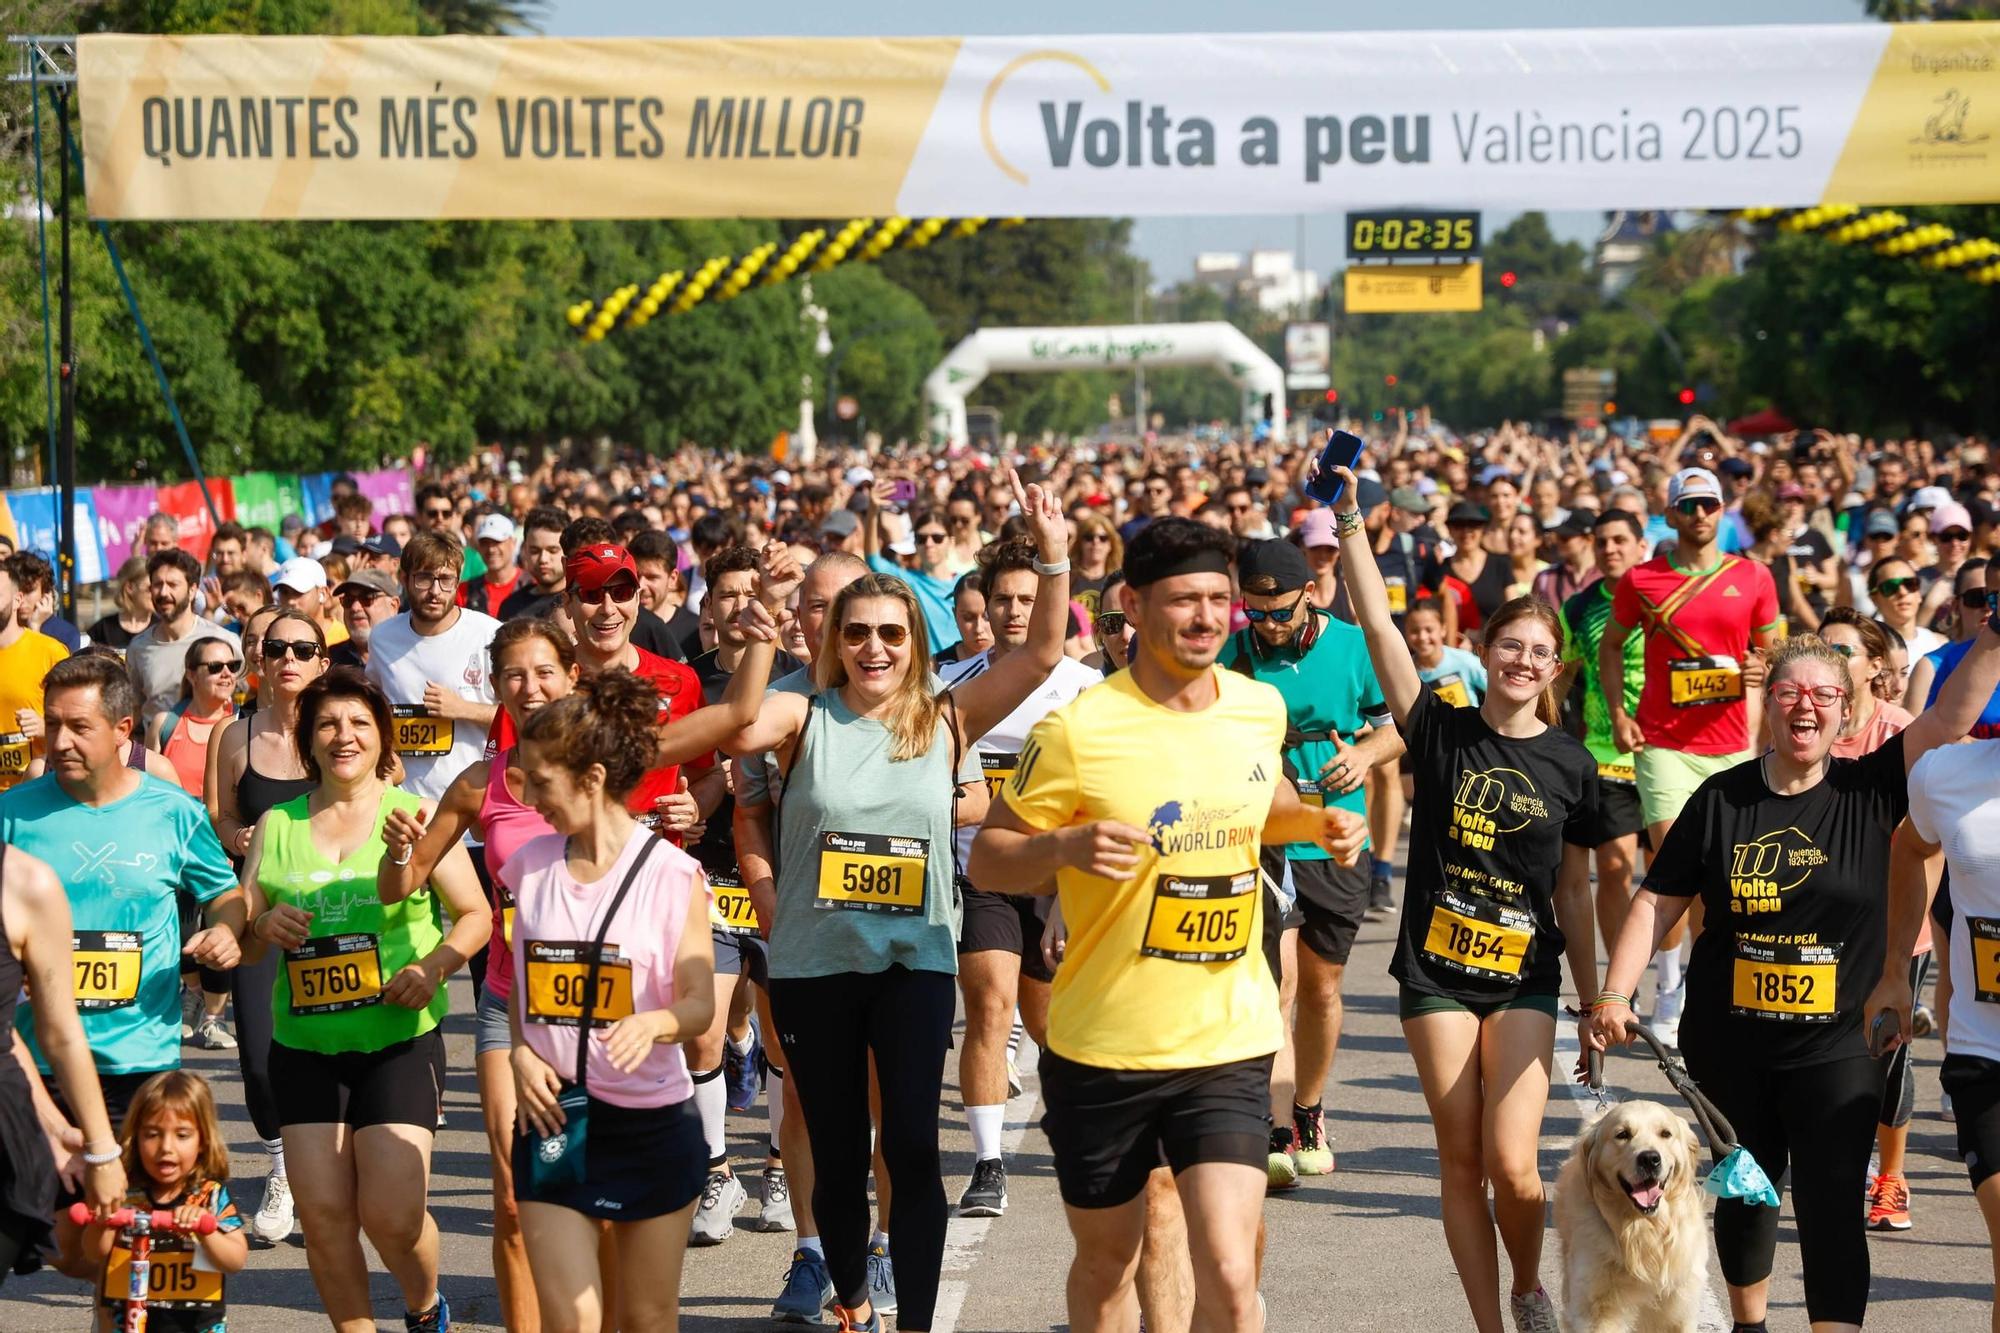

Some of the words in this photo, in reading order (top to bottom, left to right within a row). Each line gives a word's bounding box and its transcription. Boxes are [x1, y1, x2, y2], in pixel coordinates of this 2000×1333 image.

[142, 96, 359, 166] QUANTES
[380, 82, 478, 159] MÉS
[497, 97, 664, 159] VOLTES
[687, 97, 865, 159] MILLOR
[1040, 101, 1215, 168] Volta
[1240, 117, 1279, 166] a
[1304, 113, 1430, 183] peu
[1452, 109, 1662, 164] València
[1682, 106, 1802, 160] 2025
[1353, 219, 1473, 250] 0:02:35
[1685, 675, 1727, 696] 1443
[399, 725, 437, 745] 9521
[0, 750, 22, 767] 89
[1453, 805, 1497, 836] Volta
[1510, 801, 1549, 818] 1924-2024
[1168, 829, 1226, 853] WORLD
[1228, 825, 1256, 848] RUN
[1449, 824, 1458, 841] a
[1461, 828, 1496, 852] peu
[1788, 854, 1829, 866] 1924-2024
[842, 863, 902, 896] 5981
[1444, 862, 1462, 876] 100
[1502, 879, 1524, 896] PEU
[1730, 878, 1778, 899] Volta
[718, 895, 755, 920] 977
[1730, 899, 1742, 913] a
[1746, 897, 1782, 916] peu
[1176, 908, 1240, 943] 4105
[1793, 932, 1818, 945] PEU
[1448, 922, 1505, 962] 1854
[1743, 944, 1757, 955] Volta
[1762, 950, 1775, 958] peu
[76, 961, 117, 990] 761
[300, 963, 361, 998] 5760
[1753, 972, 1815, 1005] 1852
[554, 974, 614, 1009] 907
[150, 1262, 197, 1292] 015
